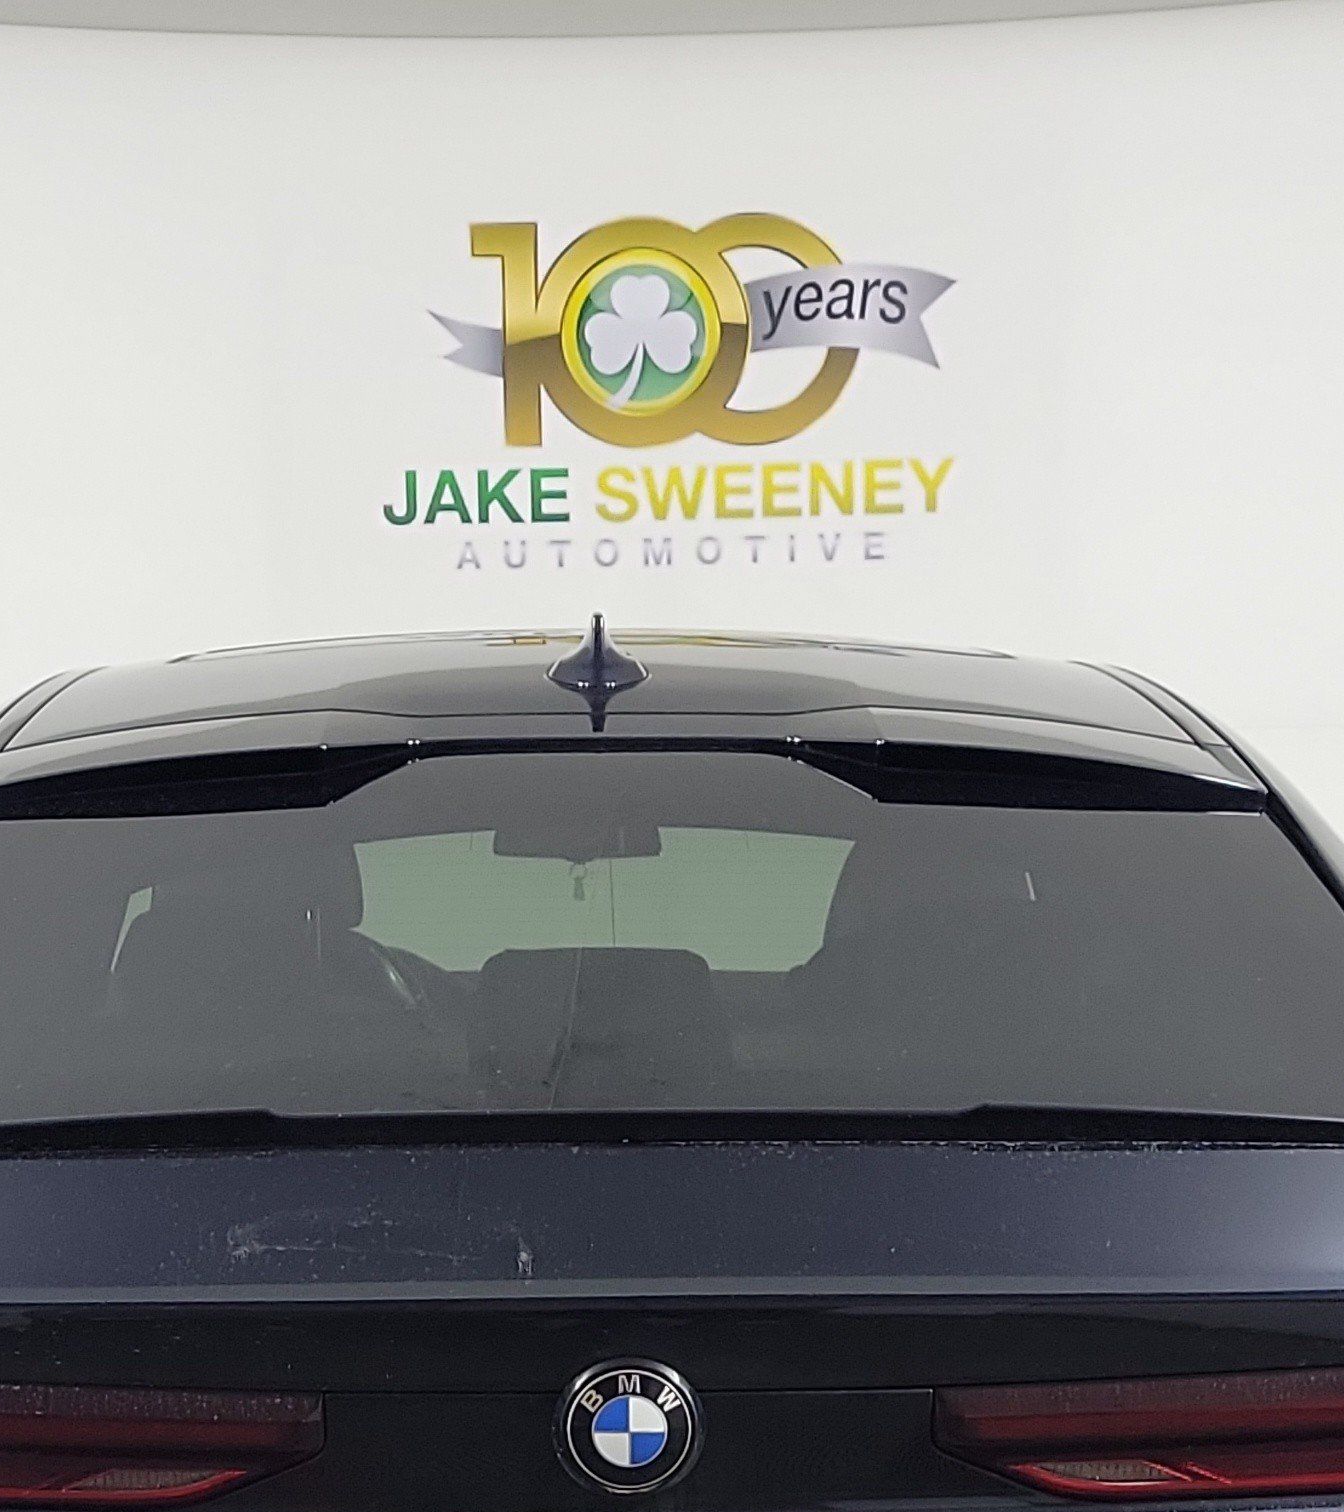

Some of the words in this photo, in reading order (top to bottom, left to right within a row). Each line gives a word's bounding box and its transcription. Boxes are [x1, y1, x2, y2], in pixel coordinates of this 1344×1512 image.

[761, 275, 909, 339] years
[383, 466, 570, 526] JAKE
[595, 457, 954, 521] SWEENEY
[457, 531, 887, 570] AUTOMOTIVE
[579, 1374, 682, 1413] BMW
